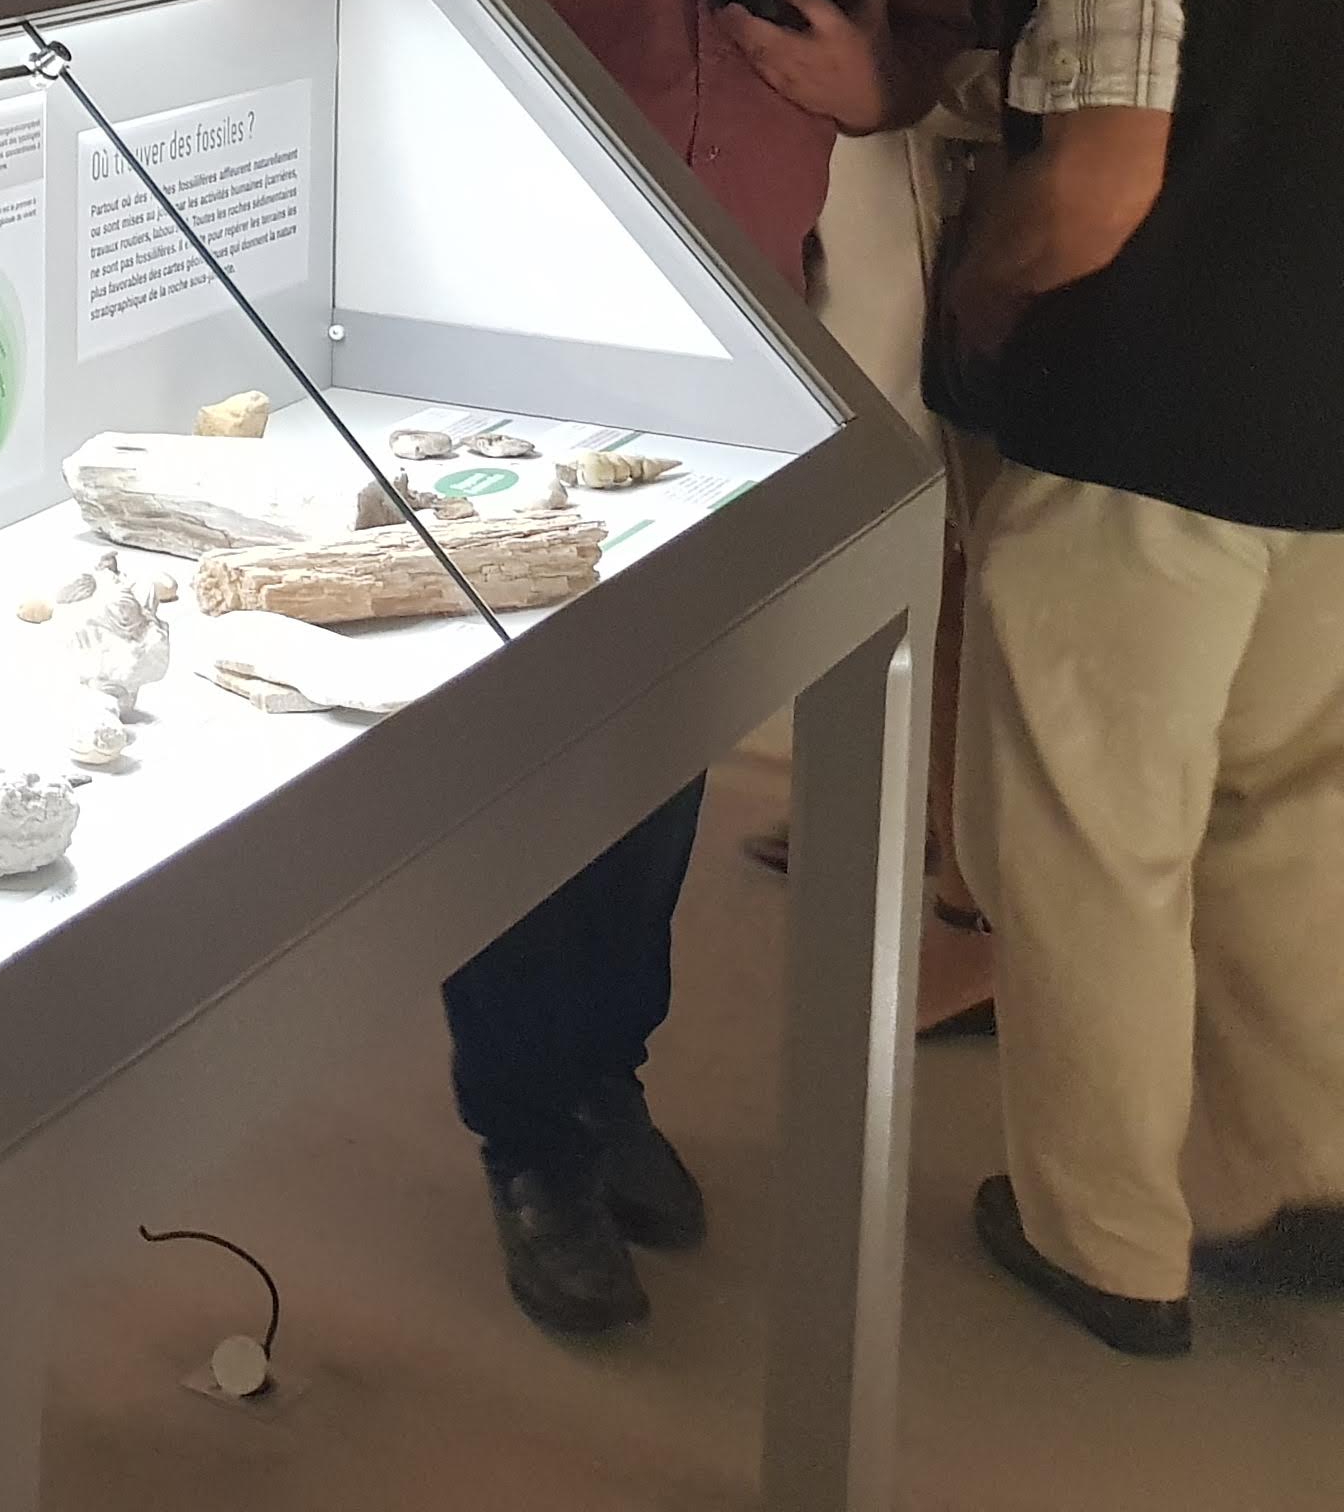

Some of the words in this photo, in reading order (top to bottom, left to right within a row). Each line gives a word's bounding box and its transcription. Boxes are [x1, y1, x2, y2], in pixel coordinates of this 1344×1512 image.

[92, 149, 109, 181] Où
[169, 131, 192, 160] des
[196, 116, 244, 153] fossiles
[248, 111, 255, 139] ?
